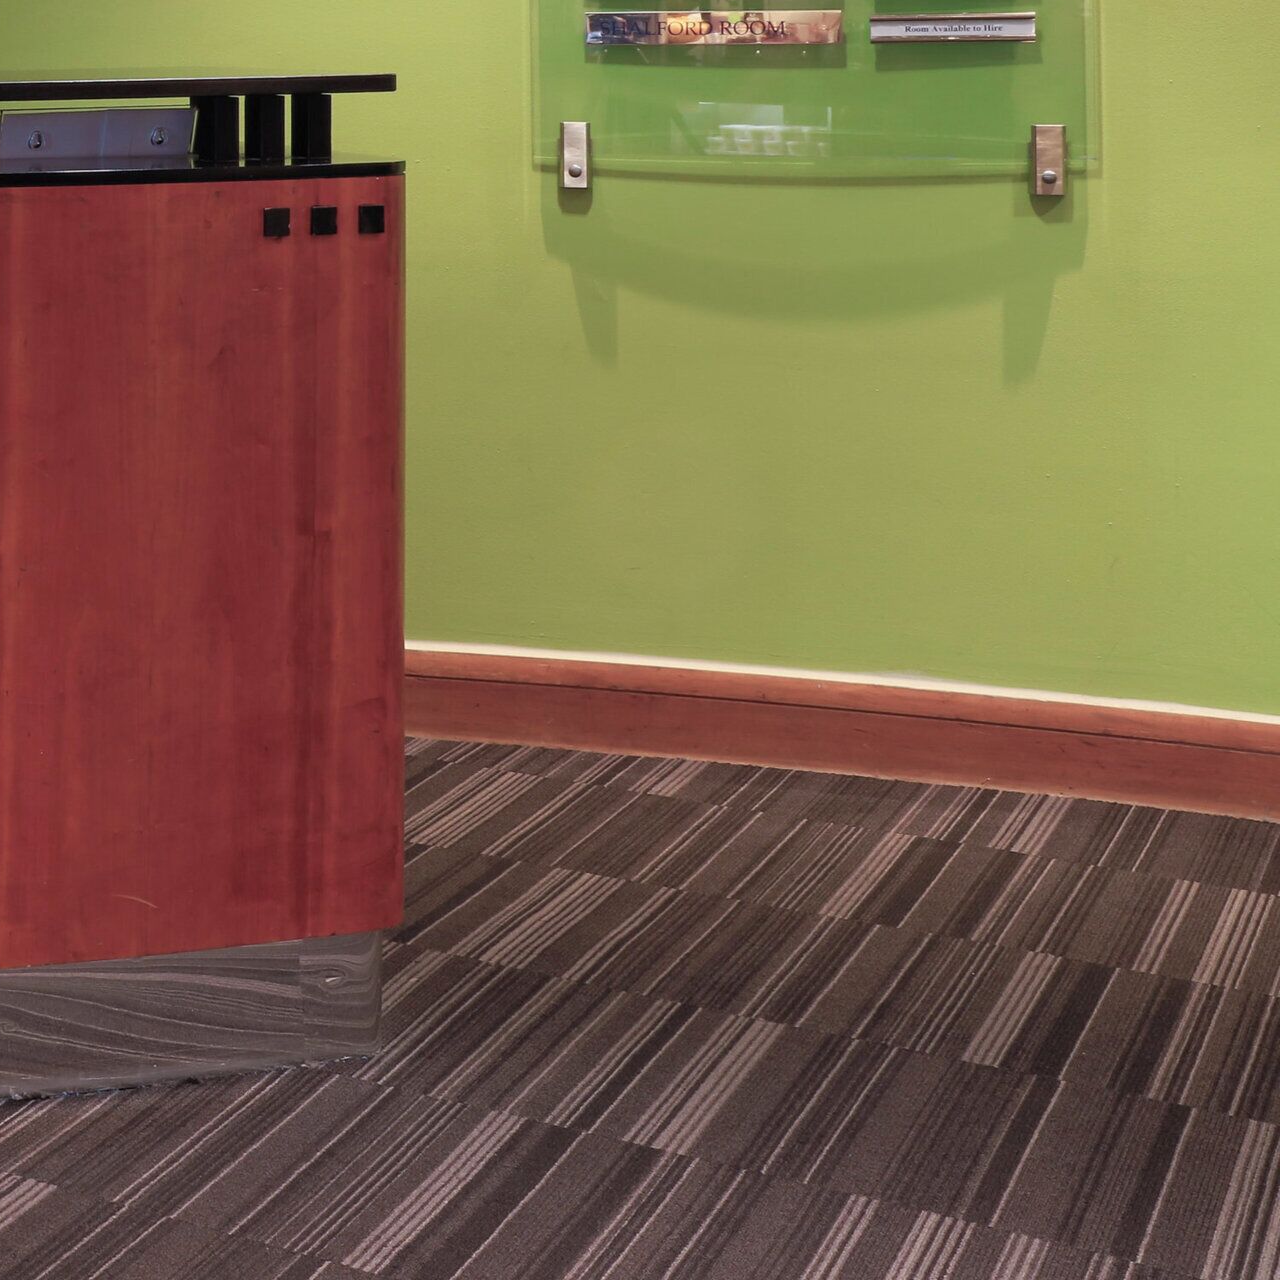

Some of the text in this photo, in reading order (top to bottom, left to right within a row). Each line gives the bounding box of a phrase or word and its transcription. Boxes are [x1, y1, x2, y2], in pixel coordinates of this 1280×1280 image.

[600, 20, 786, 36] SHALFORD ROOM
[905, 25, 929, 33] Room
[932, 24, 970, 32] Available
[984, 24, 1003, 32] Hire
